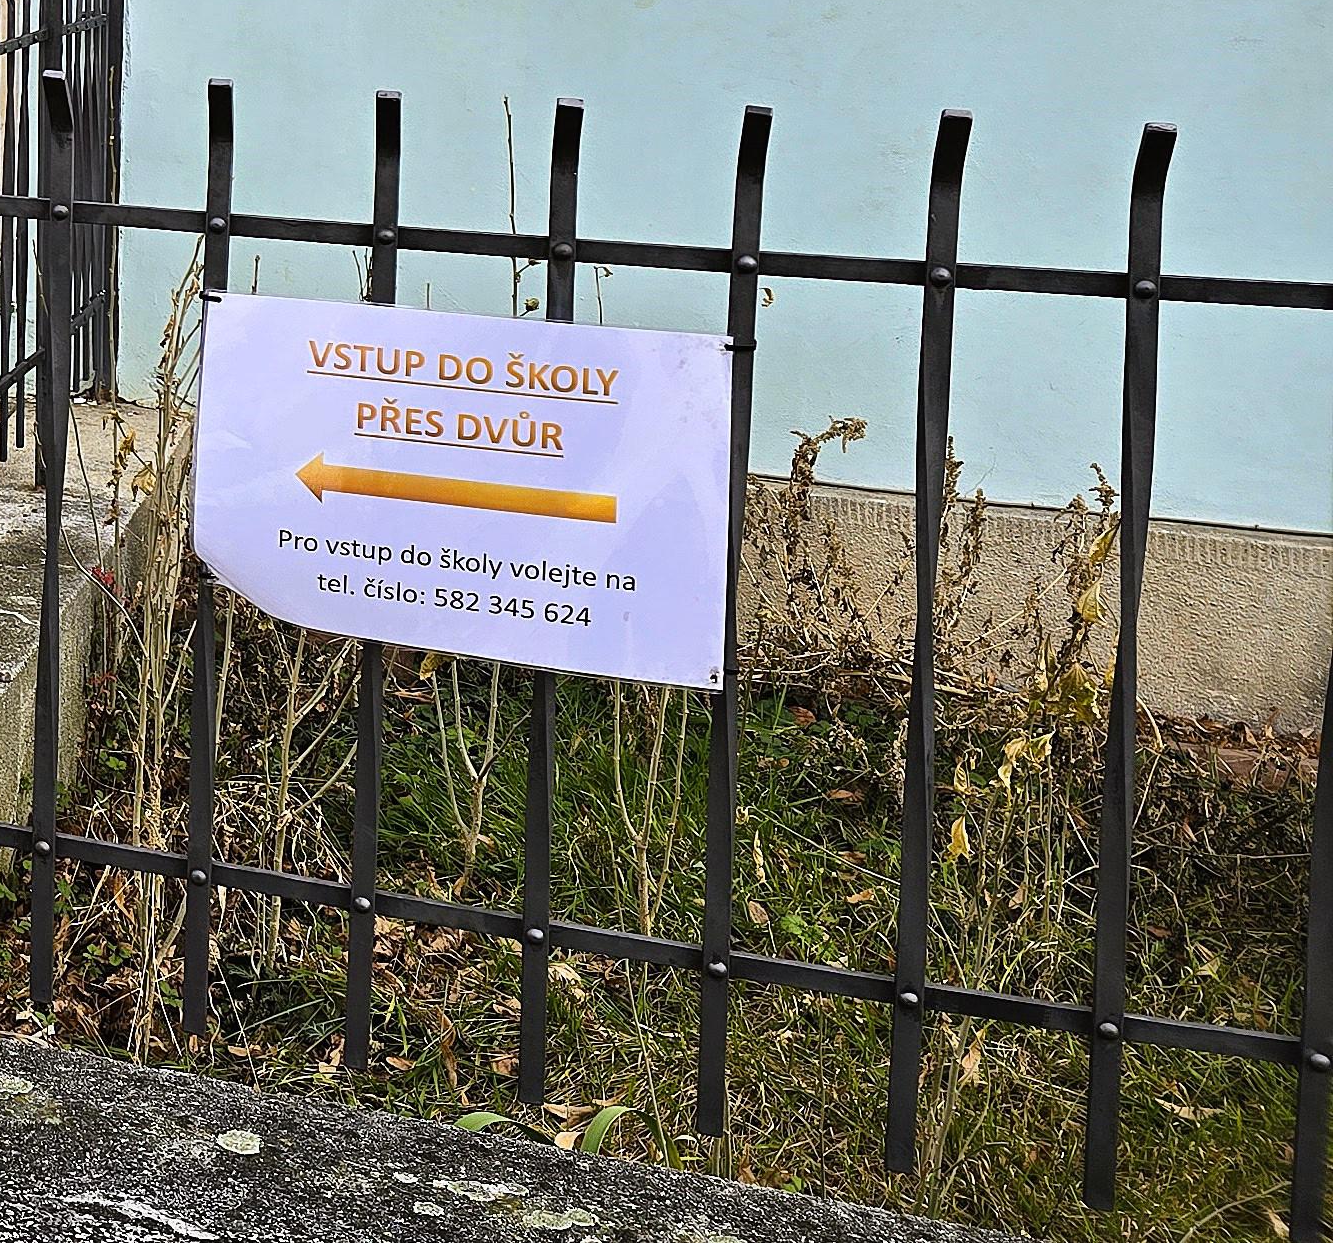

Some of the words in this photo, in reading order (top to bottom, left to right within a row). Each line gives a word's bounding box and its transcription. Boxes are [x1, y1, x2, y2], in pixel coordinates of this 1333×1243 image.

[308, 340, 425, 378] VSTUP
[438, 354, 492, 386] DO
[506, 352, 620, 397] ŠKOLY
[356, 397, 444, 438] PŘES
[457, 410, 564, 451] DVŮR
[278, 529, 318, 553] Pro
[325, 535, 393, 565] vstup
[400, 543, 432, 568] do
[439, 546, 502, 581] školy
[510, 557, 598, 590] volejte
[606, 571, 636, 592] na
[317, 571, 355, 597] tel.
[362, 576, 426, 606] číslo:
[433, 587, 480, 613] 582
[488, 594, 534, 620] 345
[544, 602, 591, 628] 624
